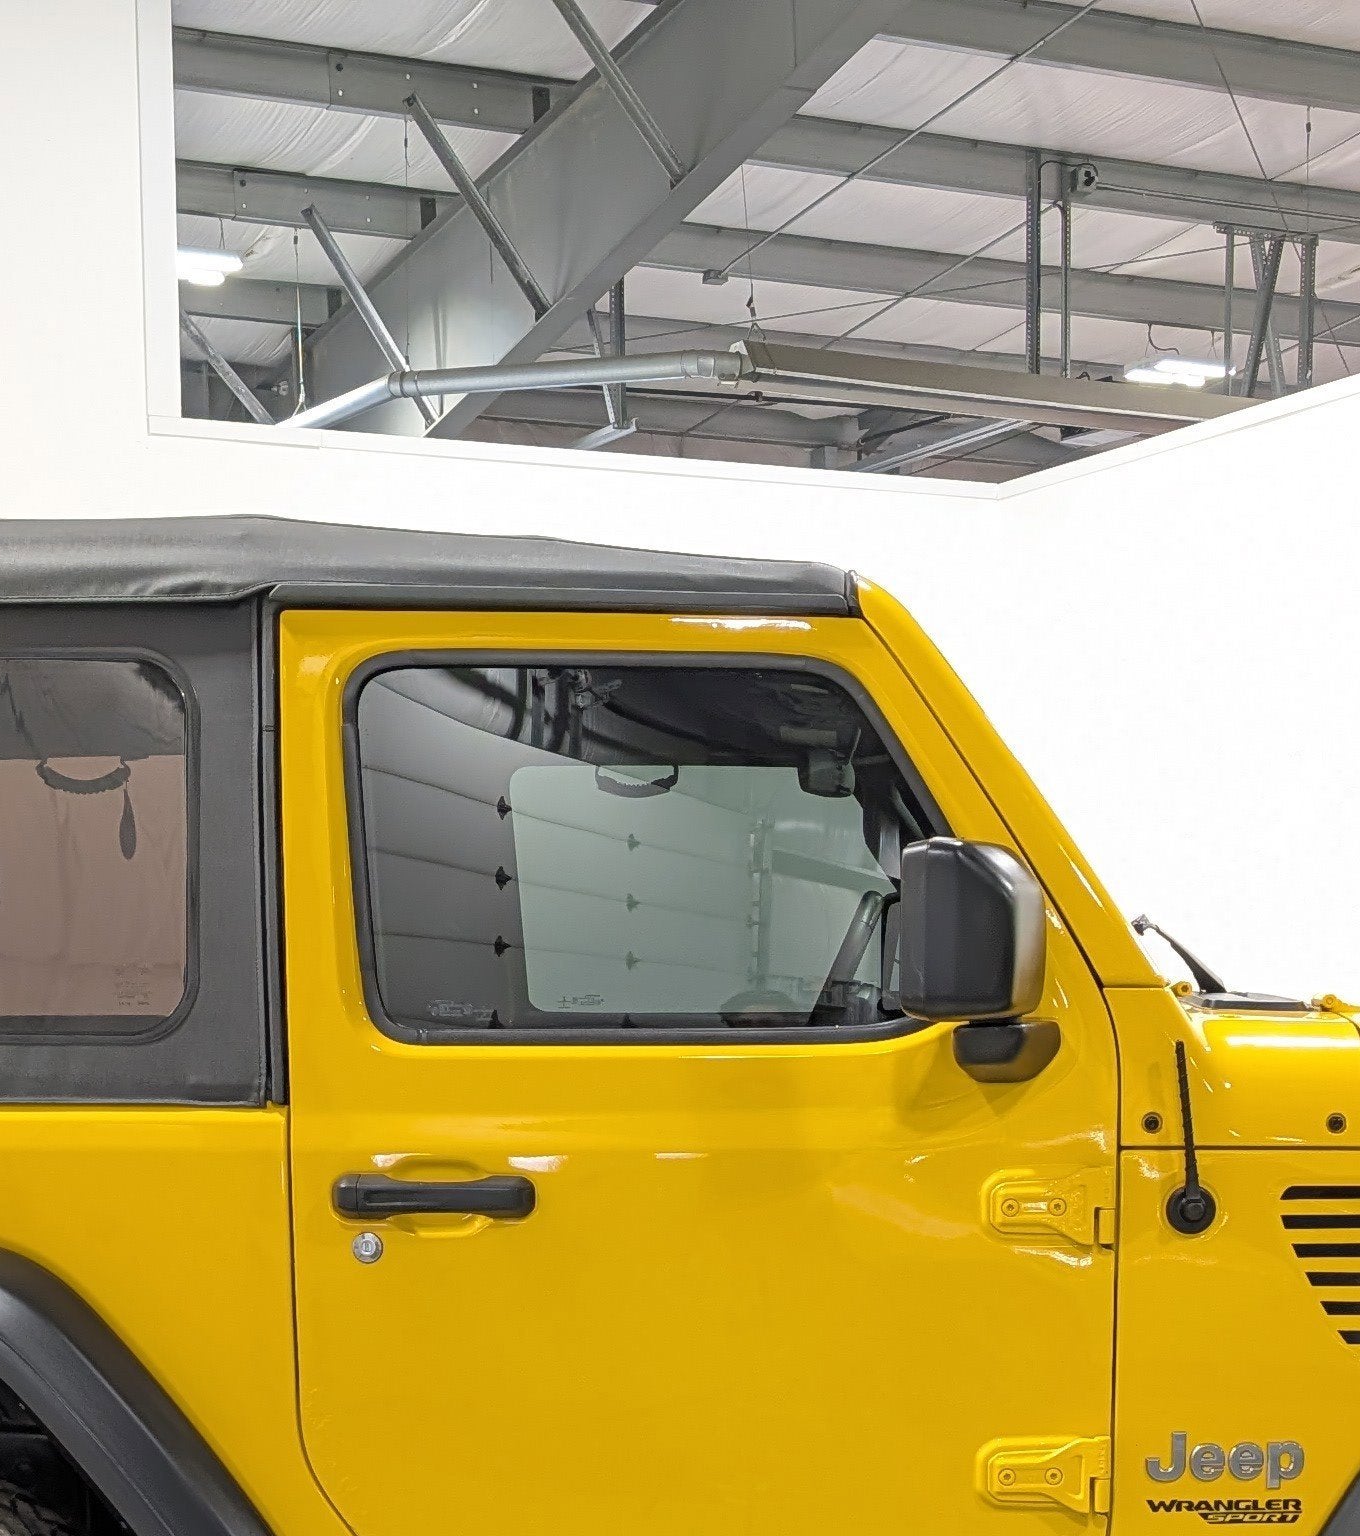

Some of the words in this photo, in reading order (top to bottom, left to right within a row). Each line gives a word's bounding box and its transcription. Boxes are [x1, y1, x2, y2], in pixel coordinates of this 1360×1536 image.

[1146, 1431, 1304, 1489] Jeep
[1146, 1498, 1302, 1512] WRANGLER
[1208, 1513, 1300, 1523] SPORT
